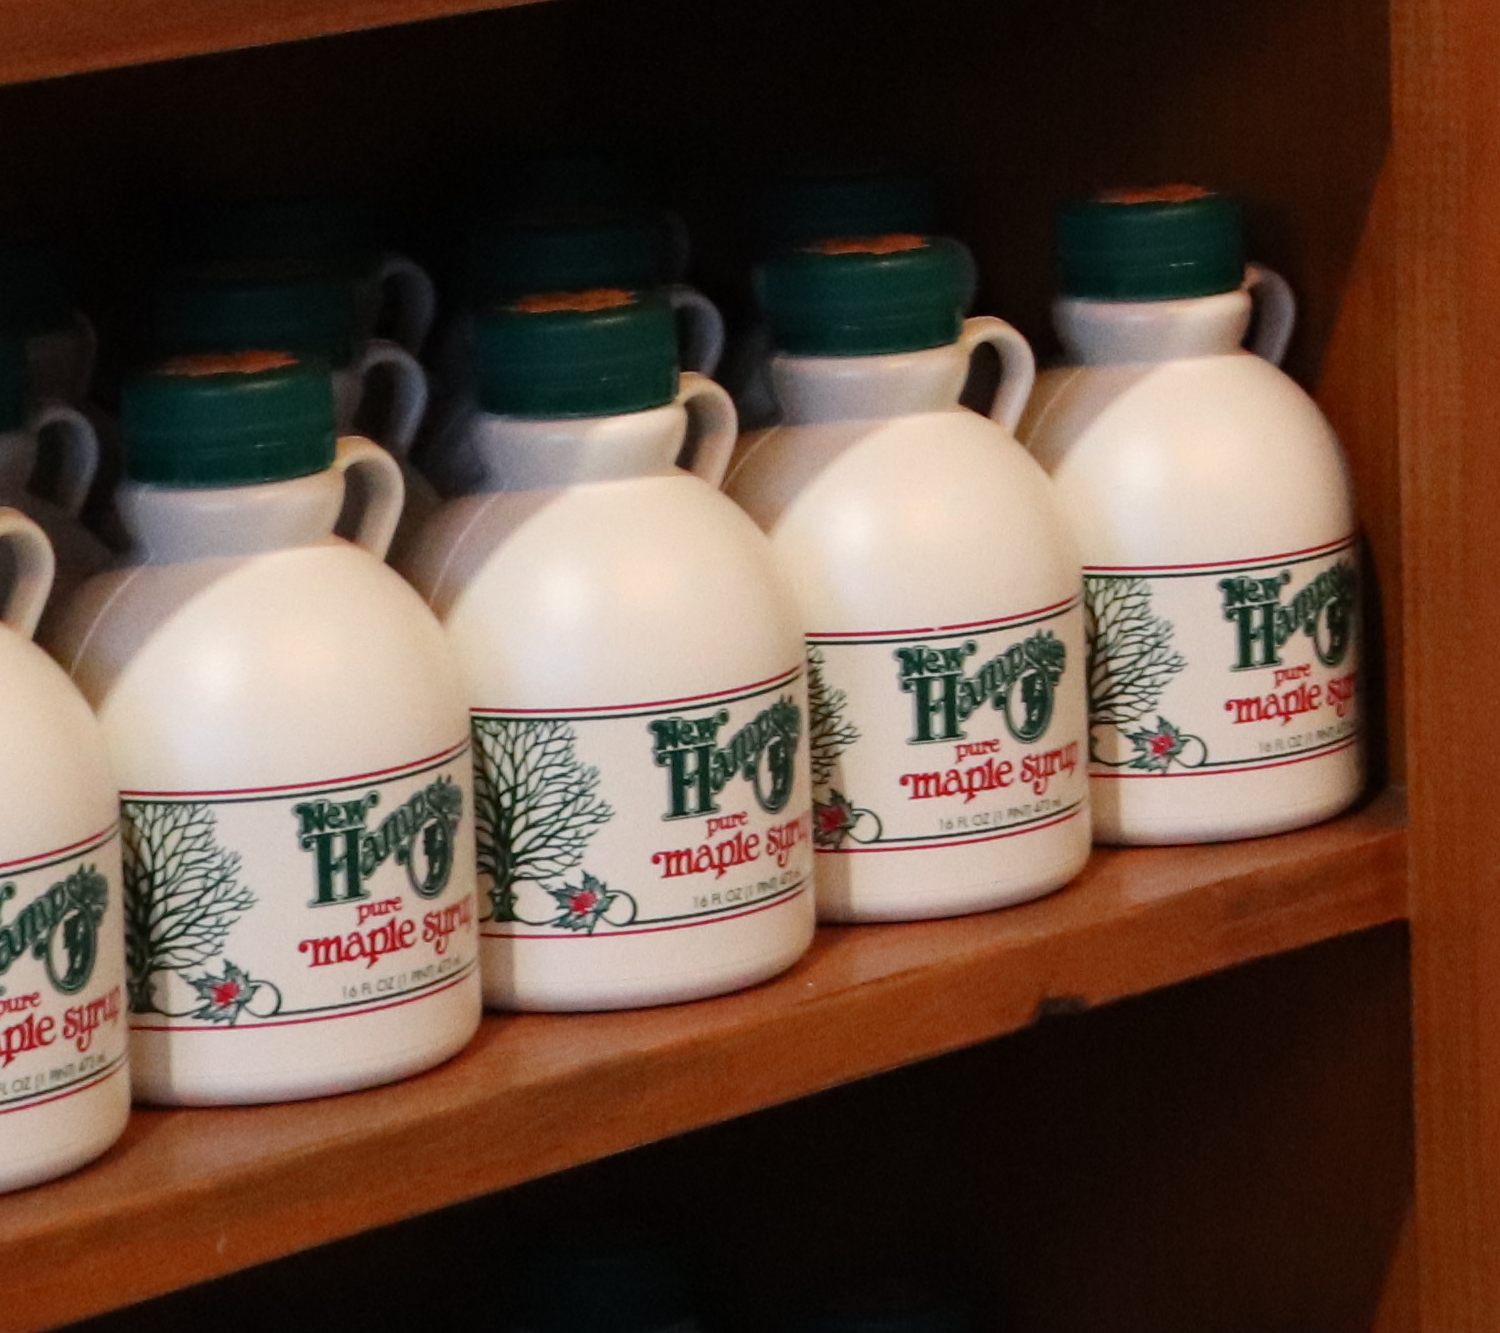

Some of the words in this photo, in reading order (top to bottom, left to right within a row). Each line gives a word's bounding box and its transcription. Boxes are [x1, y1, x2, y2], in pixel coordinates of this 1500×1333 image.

[1273, 663, 1311, 689] pure
[1224, 683, 1321, 726] maple
[953, 738, 1000, 764] pure
[899, 758, 1014, 804] maple
[292, 790, 380, 833] New
[706, 811, 748, 839] pure
[651, 831, 760, 879] maple
[356, 896, 404, 926] pure
[297, 917, 415, 968] maple
[11, 1078, 30, 1093] OZ
